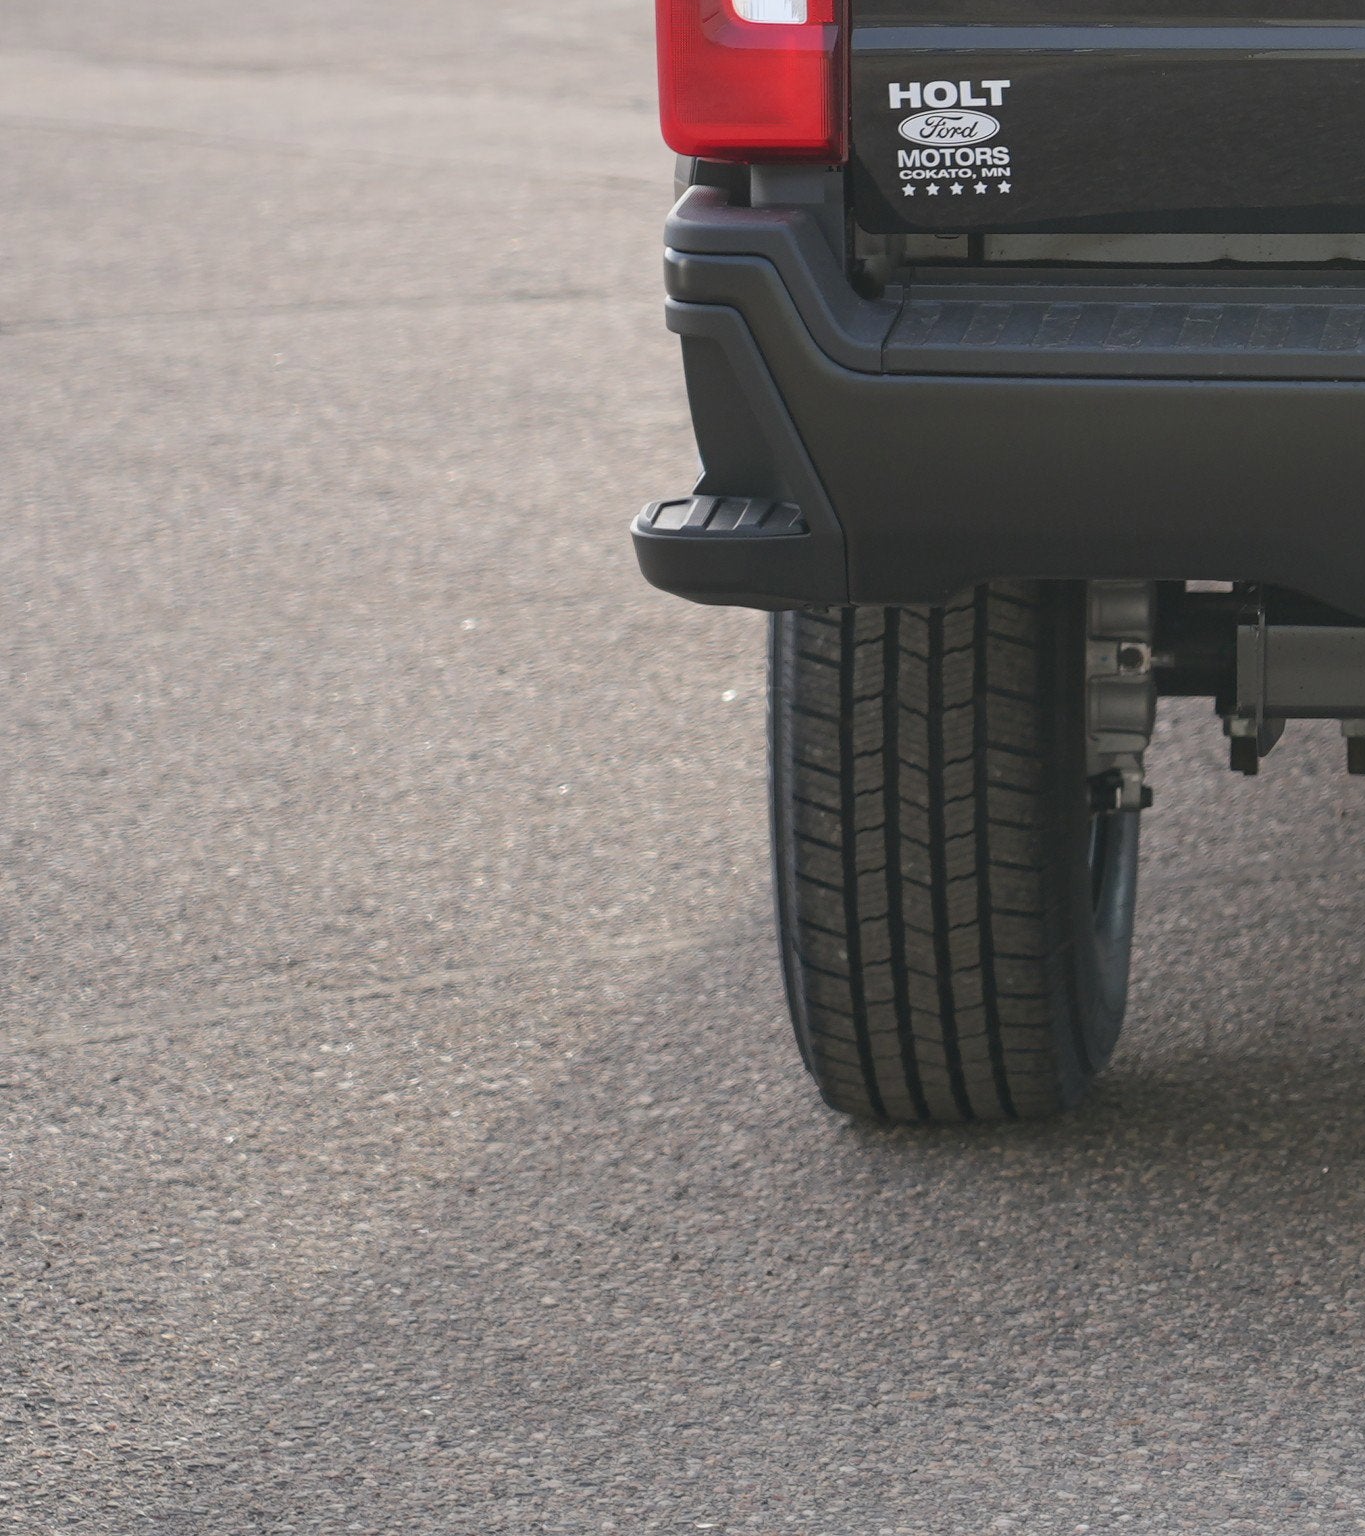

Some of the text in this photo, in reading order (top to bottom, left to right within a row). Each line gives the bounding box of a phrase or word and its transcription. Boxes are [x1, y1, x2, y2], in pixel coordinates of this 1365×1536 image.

[888, 79, 1011, 109] HOLT
[919, 115, 979, 139] Ford
[897, 146, 1011, 168] MOTORS
[899, 167, 1011, 180] COKATO, MN
